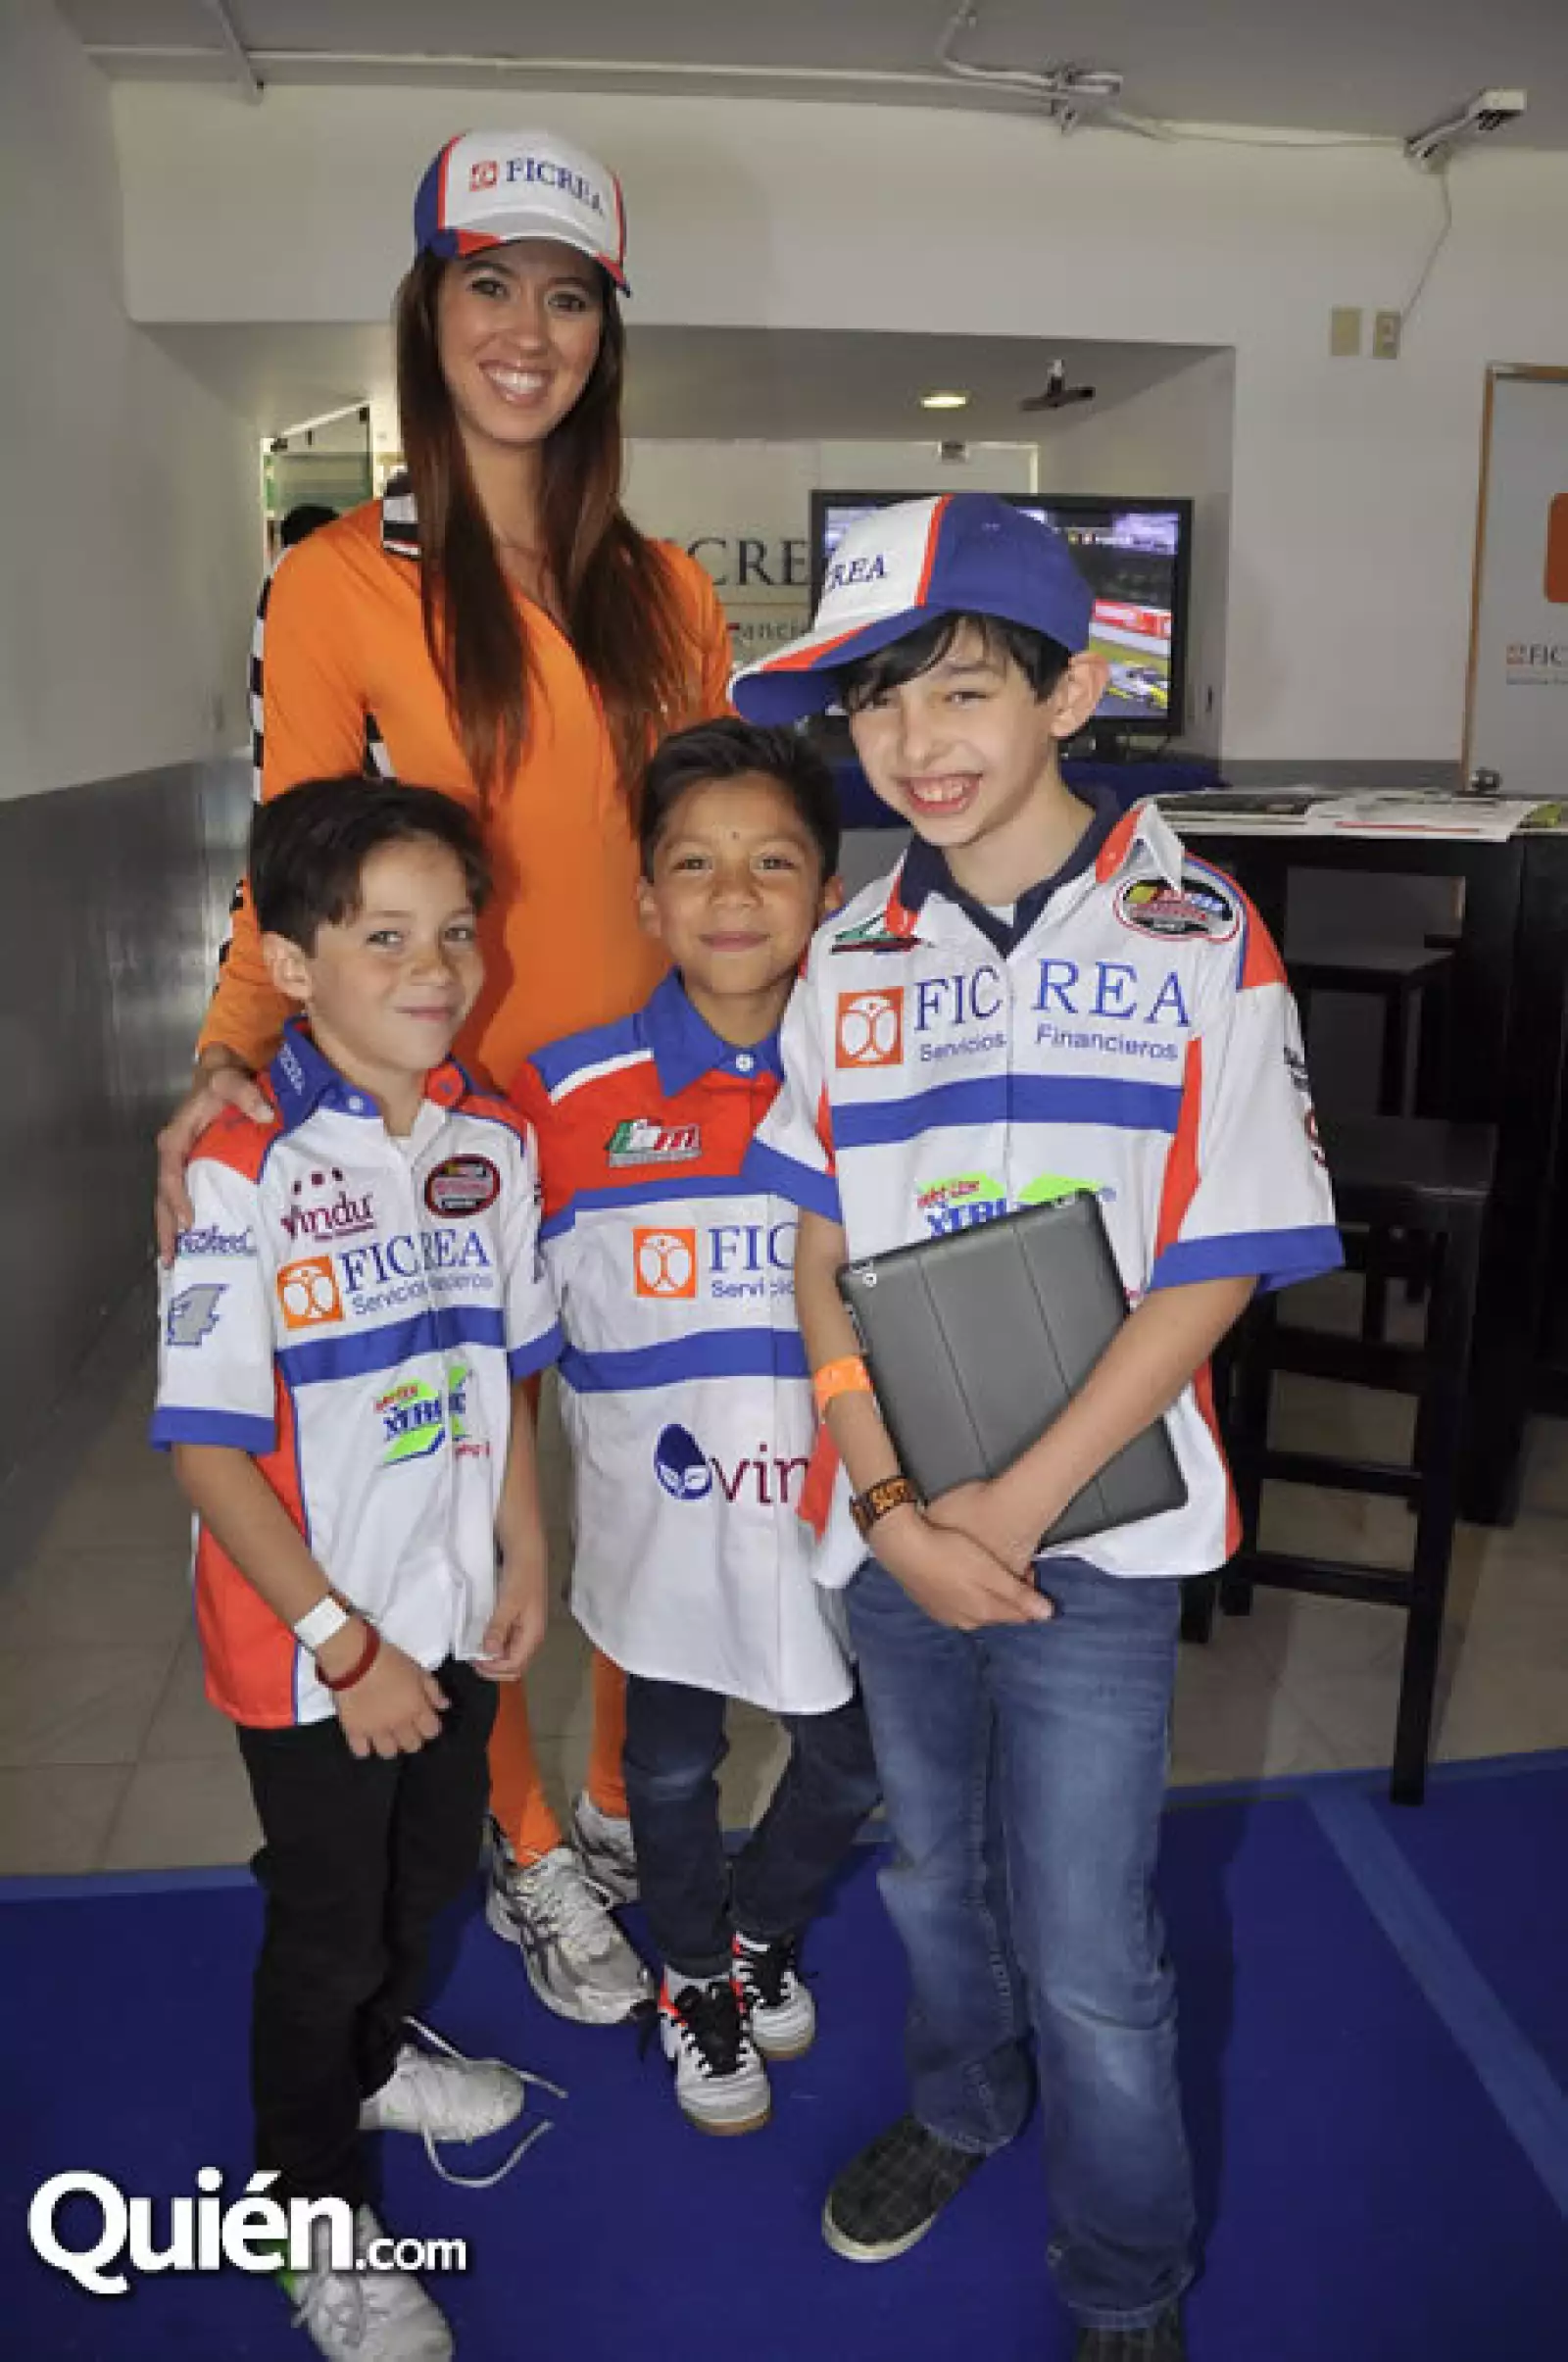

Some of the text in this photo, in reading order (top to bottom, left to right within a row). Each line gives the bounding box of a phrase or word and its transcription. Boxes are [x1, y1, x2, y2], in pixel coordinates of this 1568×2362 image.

[506, 156, 605, 217] FICREA
[919, 1023, 1178, 1062] Servicios Financieros
[708, 1221, 802, 1272] FIC
